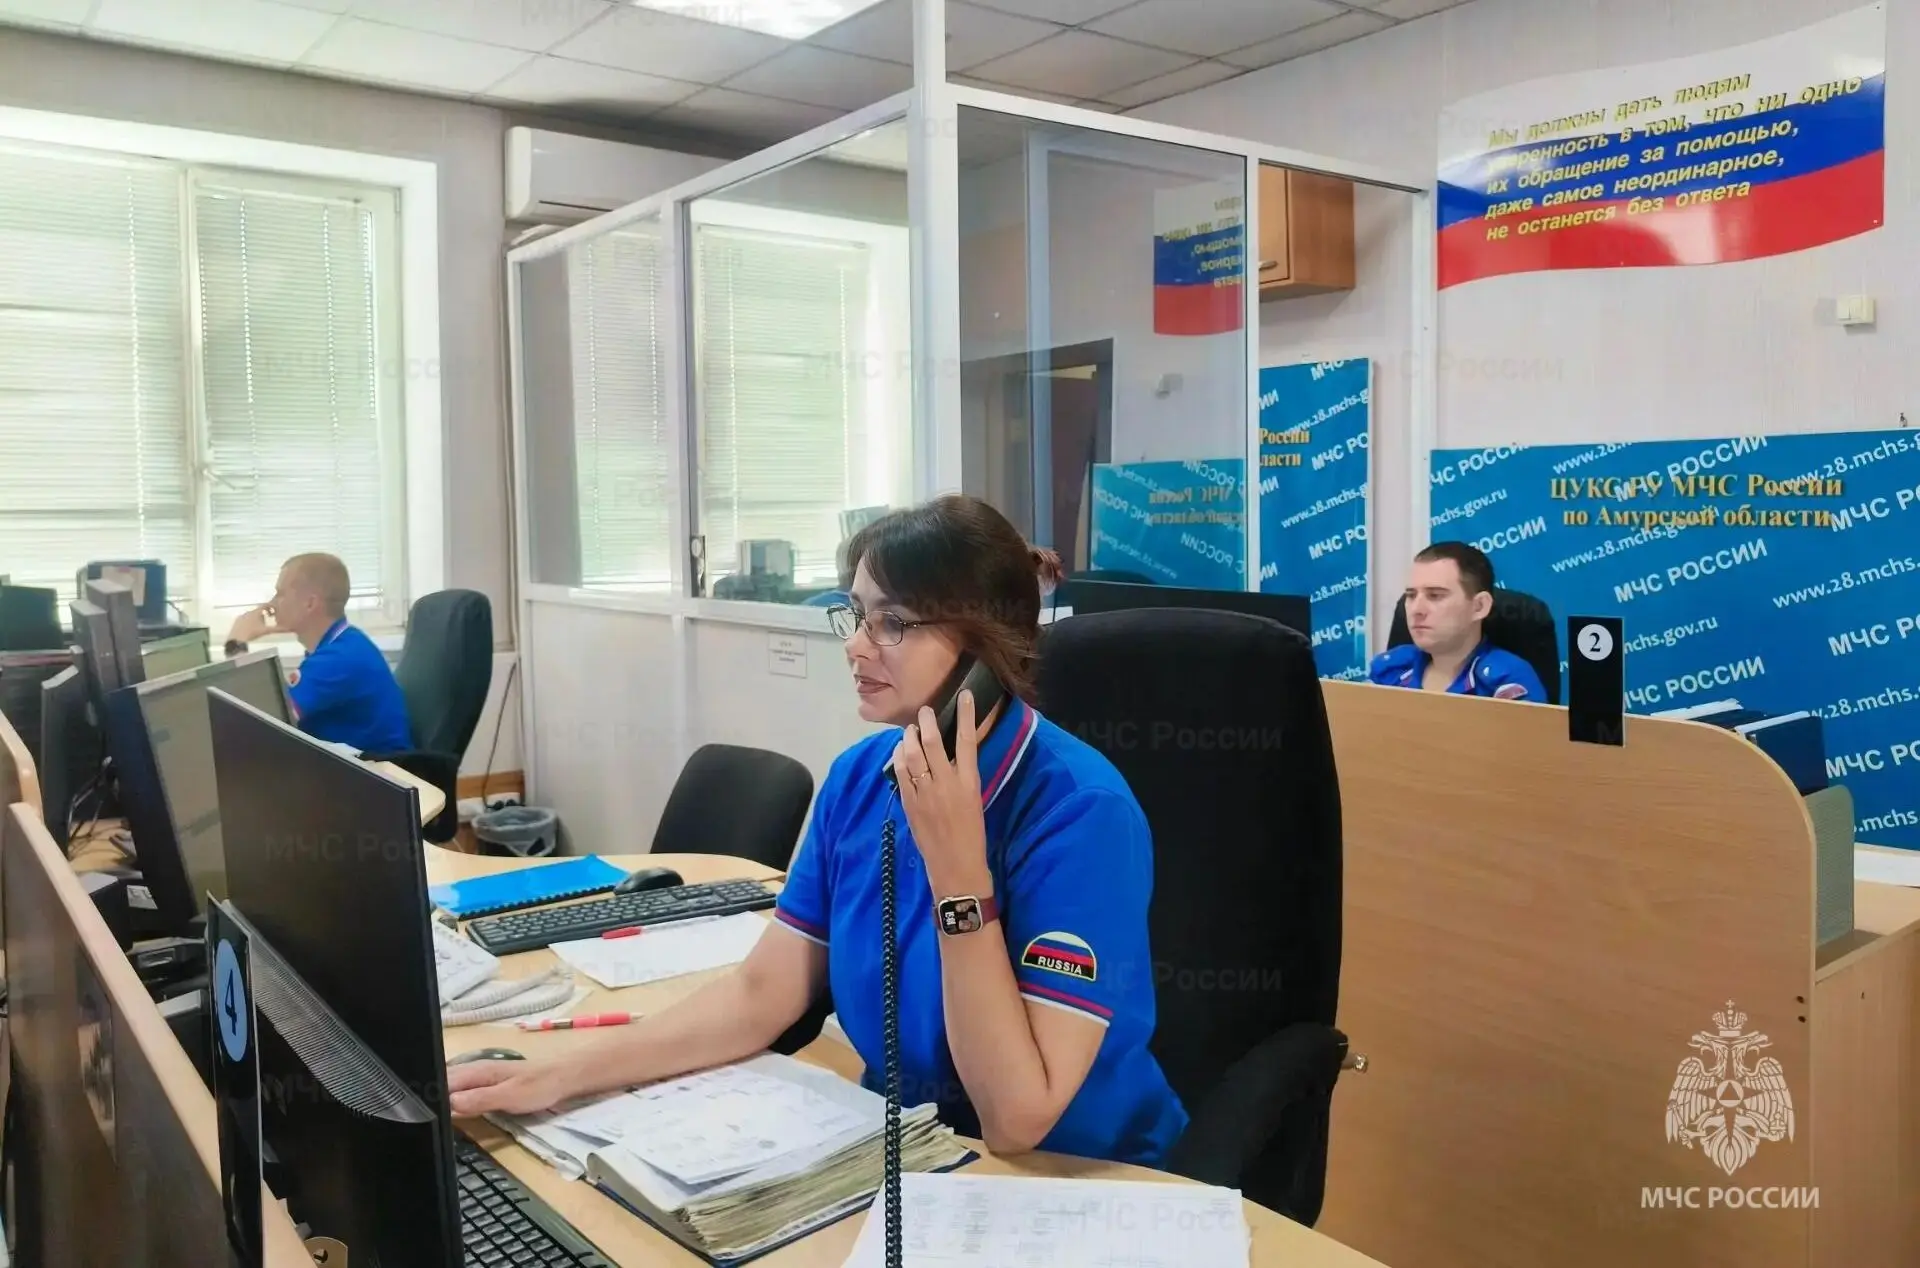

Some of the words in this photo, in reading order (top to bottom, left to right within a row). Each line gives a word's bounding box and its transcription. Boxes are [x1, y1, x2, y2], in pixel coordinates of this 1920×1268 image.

[1614, 95, 1663, 122] дать
[1673, 73, 1752, 105] людям
[1619, 126, 1635, 144] в
[1644, 113, 1693, 139] том,
[1703, 102, 1745, 124] что
[1754, 92, 1788, 113] ни
[1797, 75, 1864, 106] одно
[1486, 177, 1510, 196] их
[1518, 152, 1631, 189] обращение
[1639, 145, 1666, 165] за
[1674, 118, 1800, 157] помощью,
[1484, 196, 1535, 221] даже
[1541, 182, 1605, 208] самое
[1613, 148, 1785, 194] неординарное,
[1486, 224, 1510, 242] не
[1517, 204, 1617, 236] останется
[1626, 195, 1666, 216] без
[1674, 180, 1752, 209] ответа
[1311, 444, 1345, 471] МЧС
[1672, 473, 1739, 498] МЧС
[1747, 473, 1843, 498] России
[1563, 509, 1590, 526] по
[1594, 504, 1716, 534] Амурской
[1722, 503, 1833, 528] области
[1829, 497, 1891, 533] МЧС
[1308, 534, 1343, 560] МЧС
[1613, 573, 1664, 604] МЧС
[1666, 538, 1769, 587] РОССИИ
[1589, 631, 1602, 653] 2
[1827, 623, 1891, 657] МЧС
[1664, 655, 1766, 699] РОССИИ
[1825, 749, 1885, 779] МЧС
[1037, 955, 1082, 976] RUSSIA
[223, 967, 237, 1037] 4
